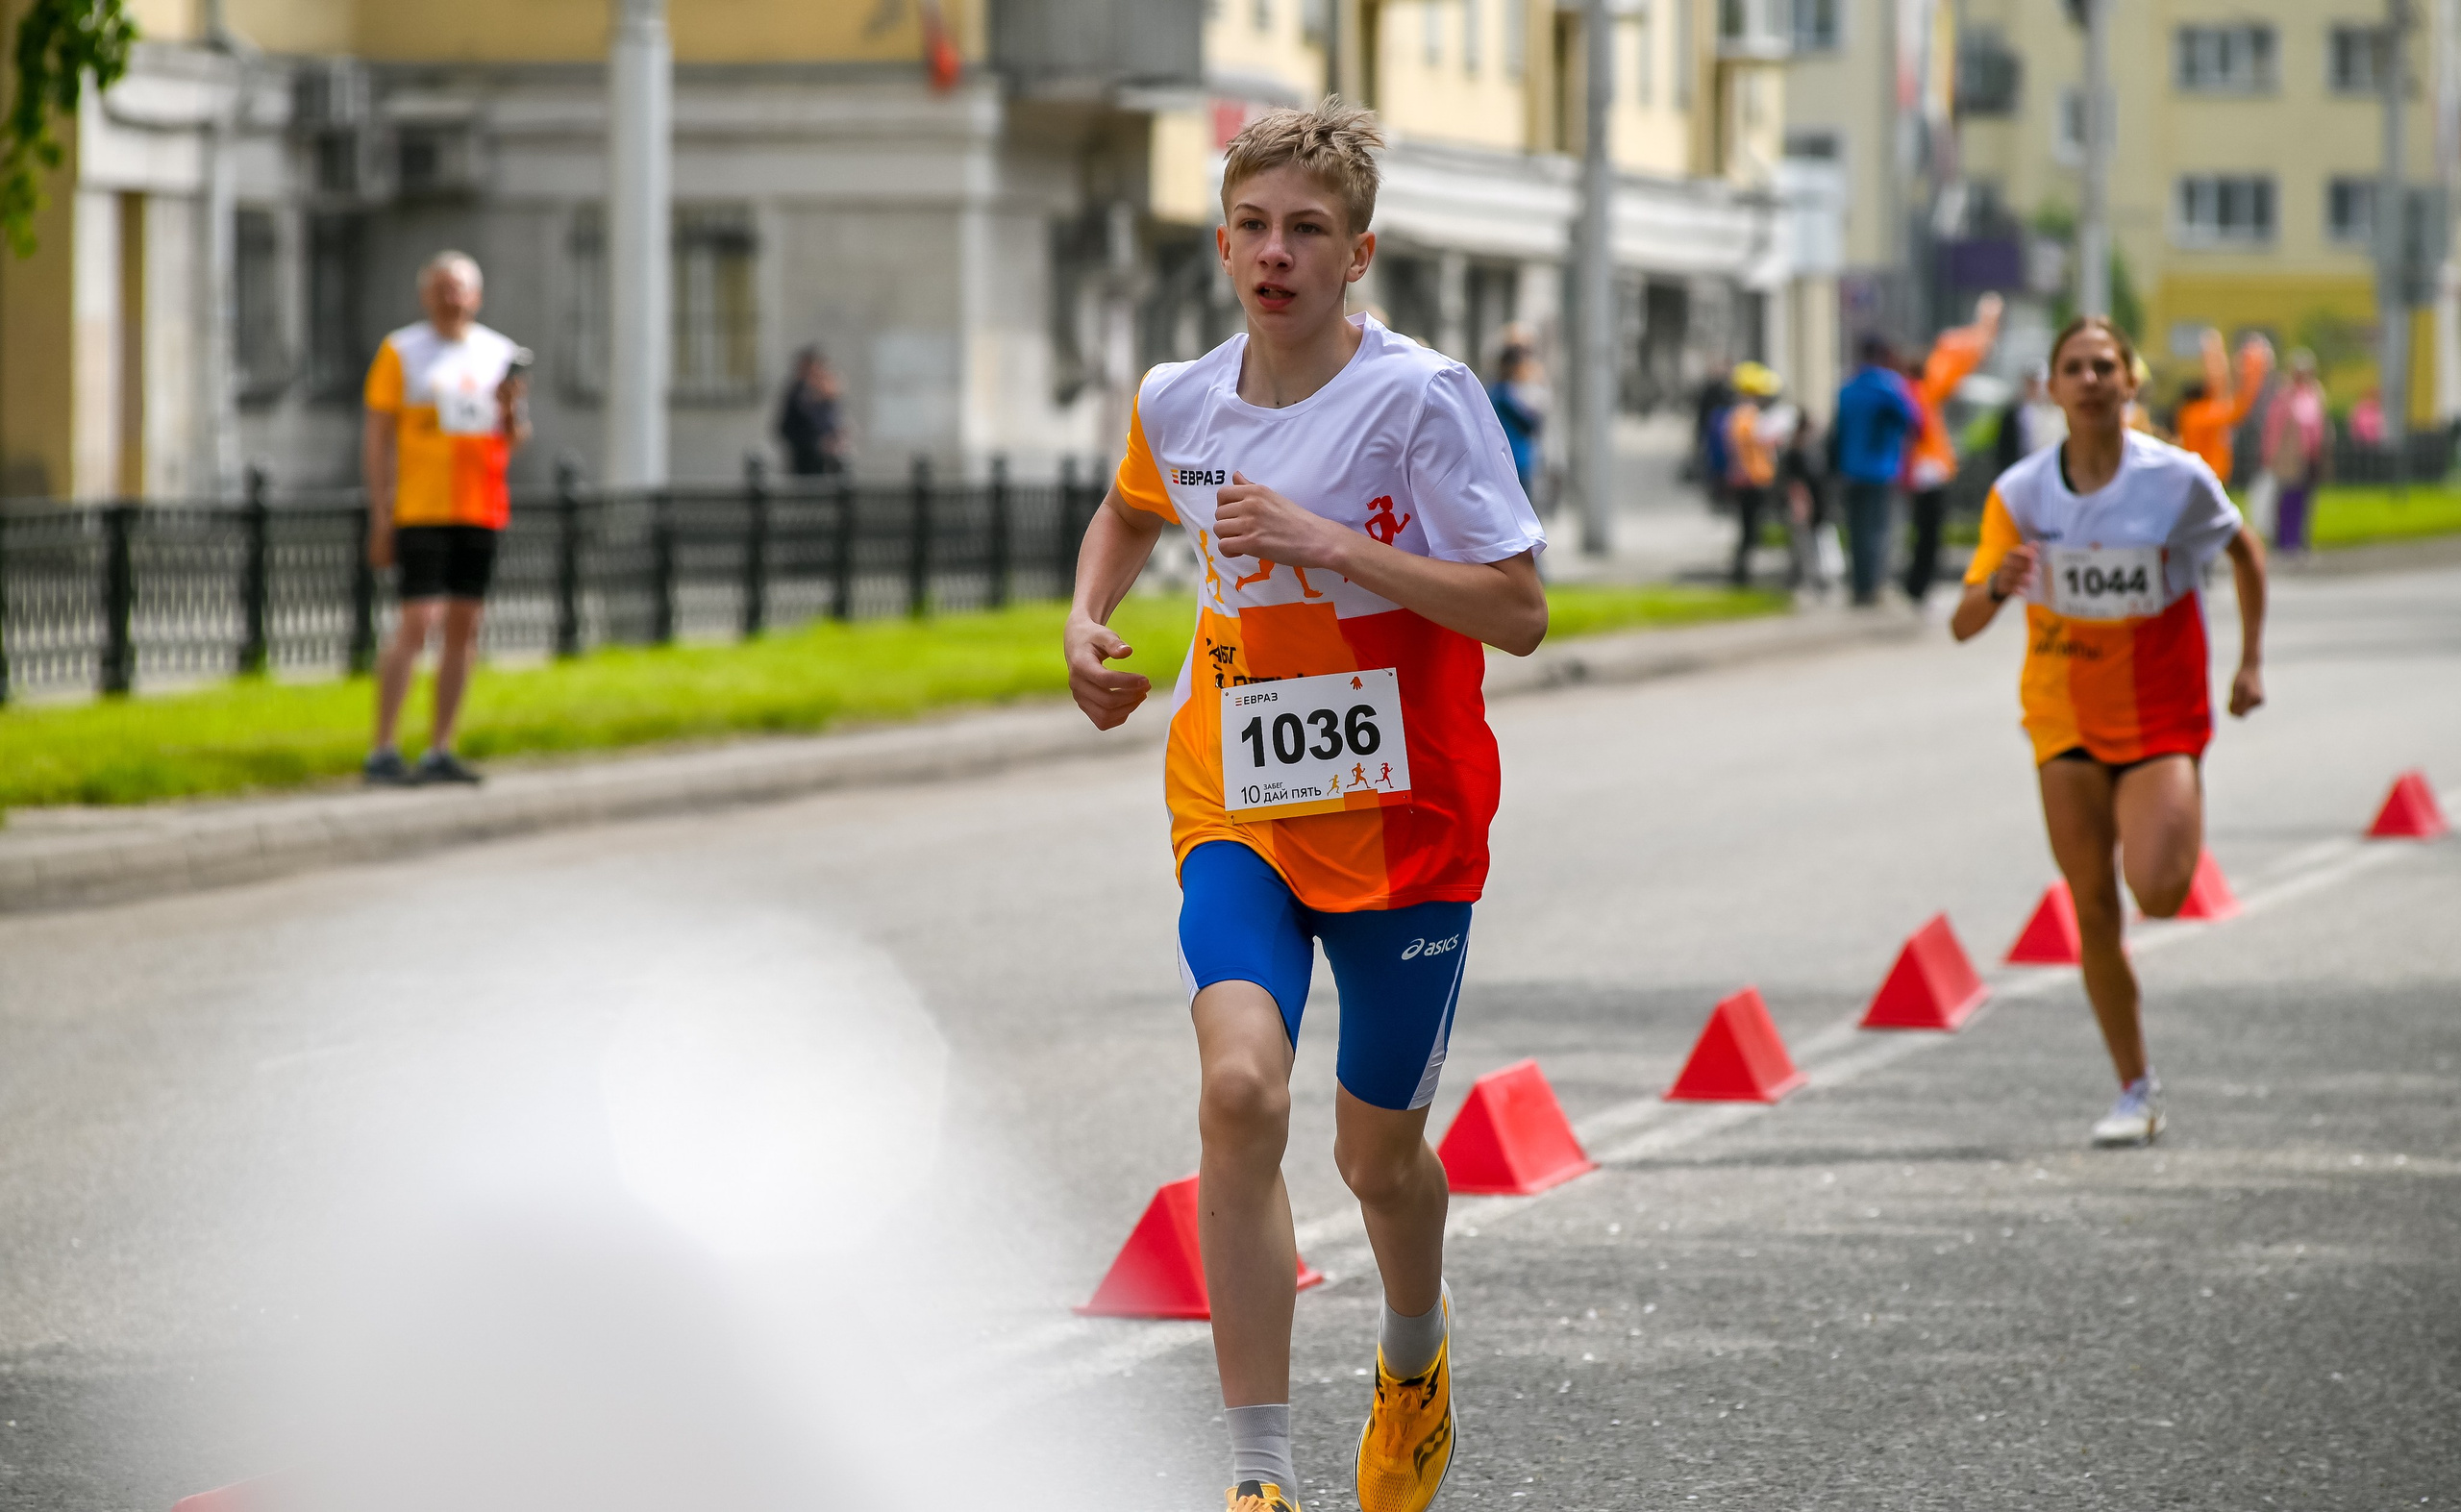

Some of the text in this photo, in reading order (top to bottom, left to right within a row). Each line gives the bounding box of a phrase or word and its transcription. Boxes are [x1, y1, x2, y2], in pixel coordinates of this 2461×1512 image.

[1180, 469, 1226, 486] ЕВРАЗ
[2064, 565, 2149, 598] 1044
[1243, 692, 1279, 706] ЕВРАЗ
[1241, 704, 1381, 768] 1036
[1240, 784, 1260, 805] 10
[1263, 781, 1283, 791] ЗАБЕГ
[1263, 786, 1322, 804] ДАЙ ПЯТЬ
[1424, 933, 1459, 956] asics
